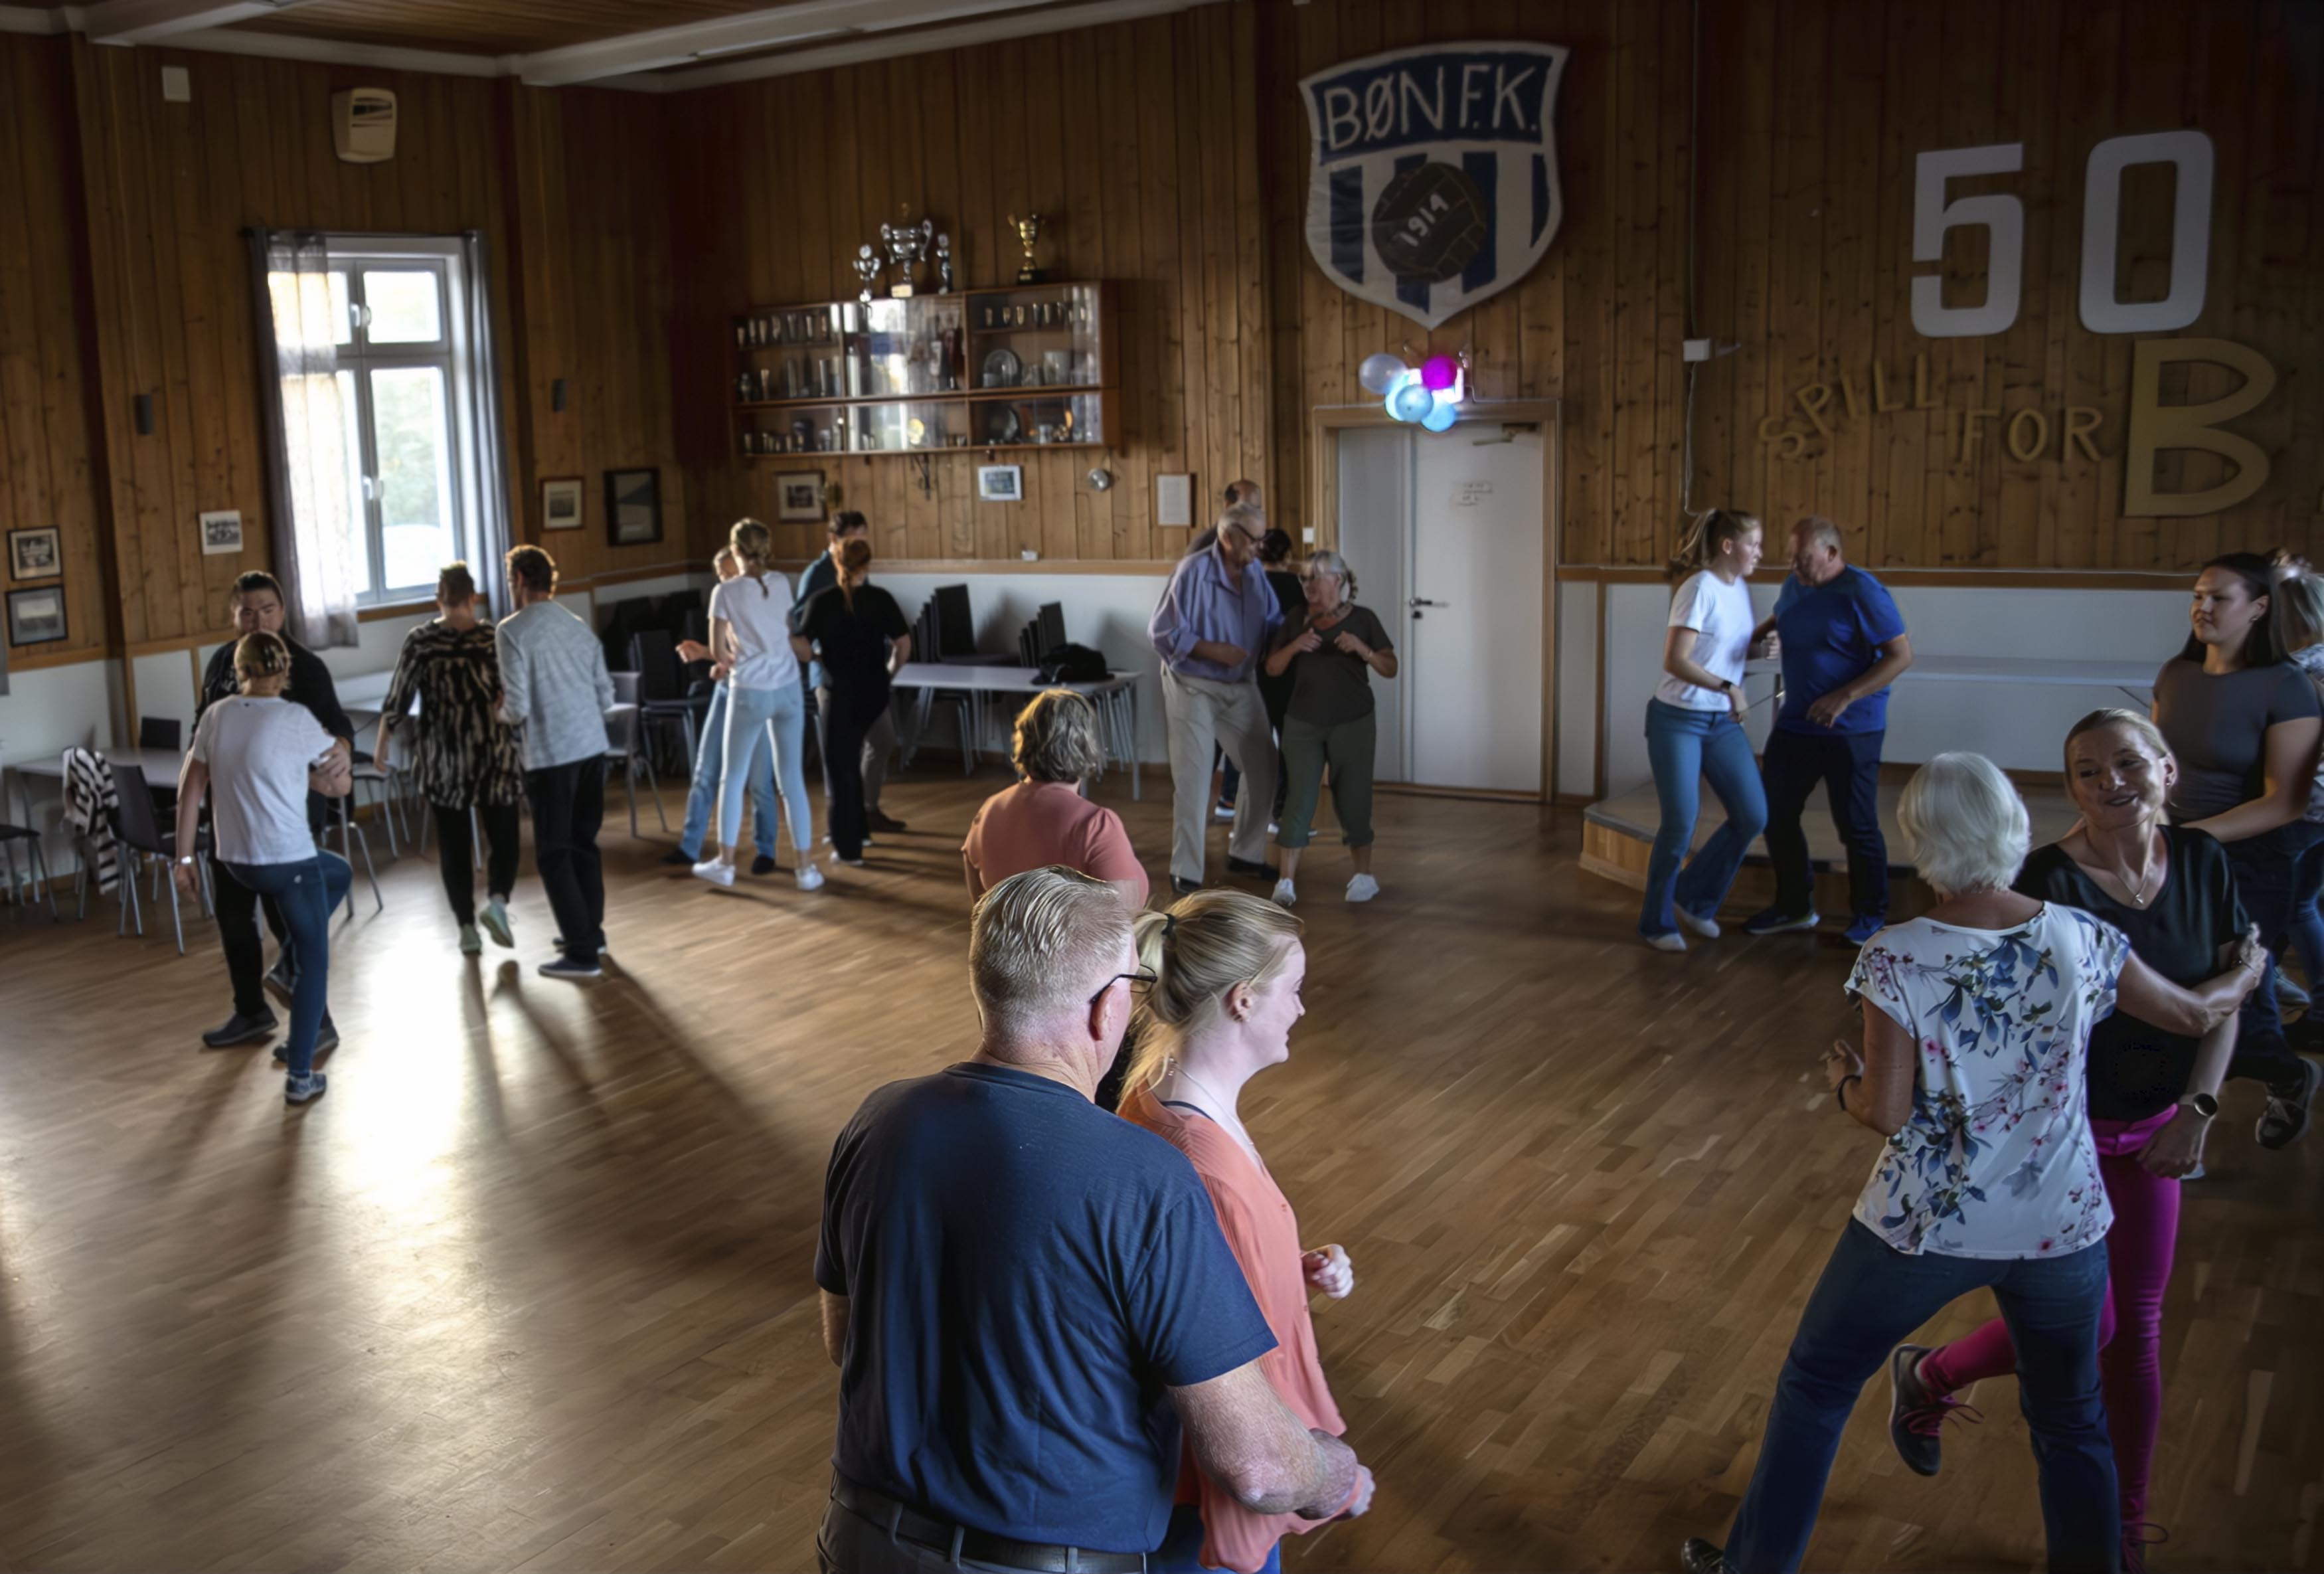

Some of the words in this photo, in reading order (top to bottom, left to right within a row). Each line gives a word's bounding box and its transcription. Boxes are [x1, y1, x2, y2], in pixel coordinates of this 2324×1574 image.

[1323, 65, 1444, 150] BØN
[1400, 193, 1449, 247] 1914
[1910, 131, 2214, 338] 50
[1758, 353, 1943, 460] SPILL
[1961, 406, 2104, 464] FOR
